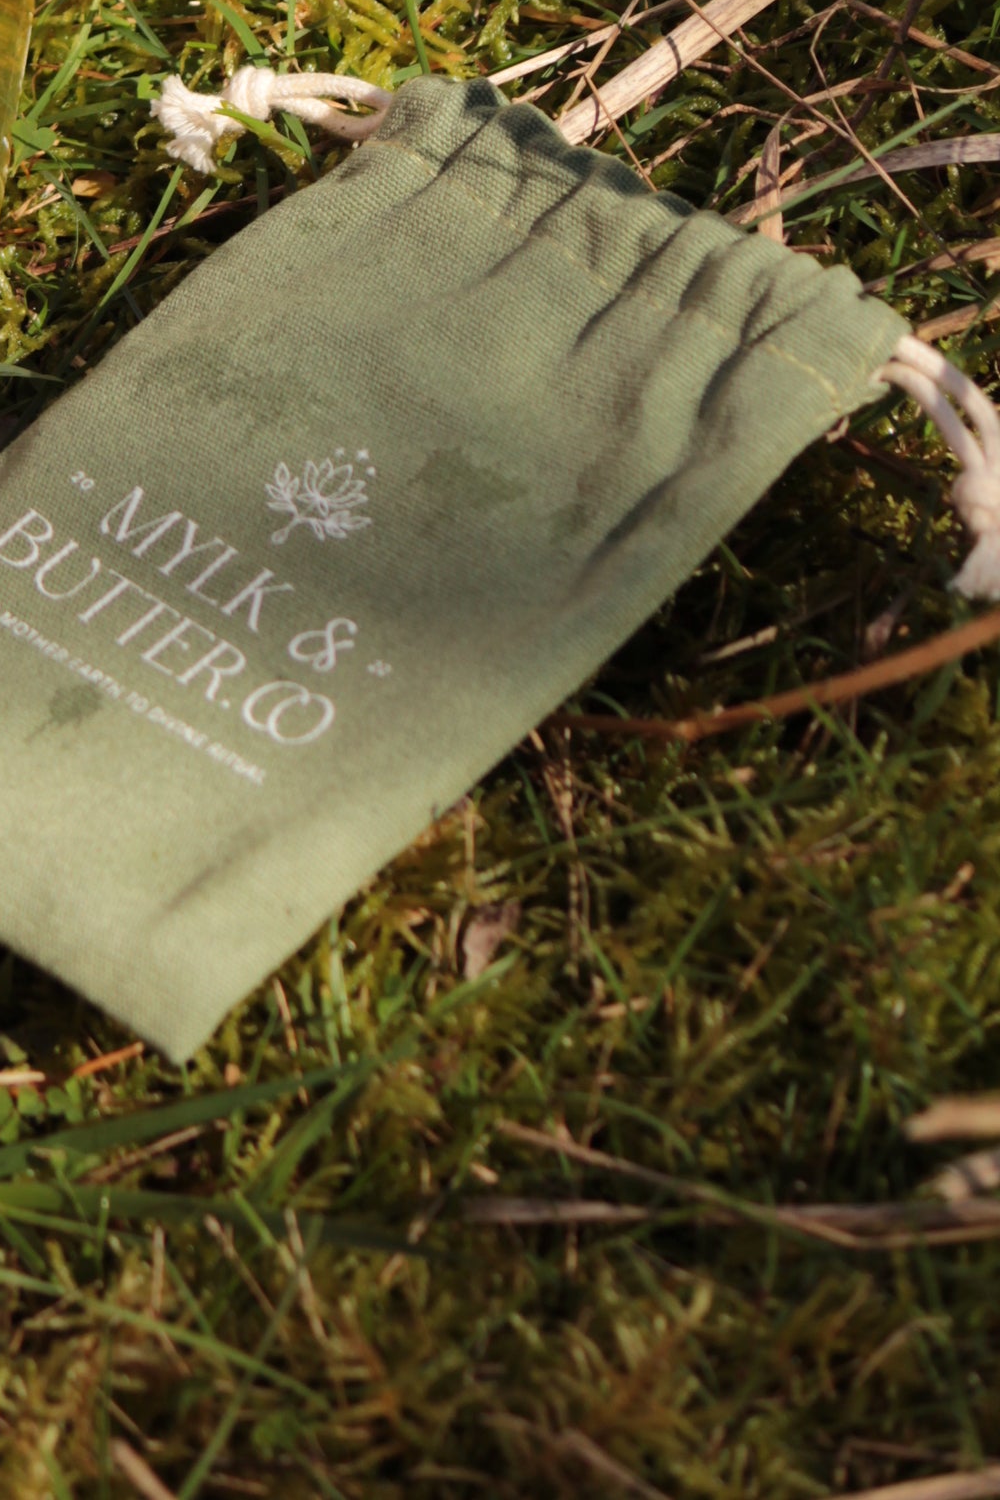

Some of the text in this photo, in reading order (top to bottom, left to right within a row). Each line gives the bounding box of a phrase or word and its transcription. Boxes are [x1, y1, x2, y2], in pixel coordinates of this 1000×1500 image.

[70, 470, 96, 491] 20
[100, 485, 358, 673] MYLK &
[68, 655, 125, 700] EARTH
[126, 691, 150, 714] TO
